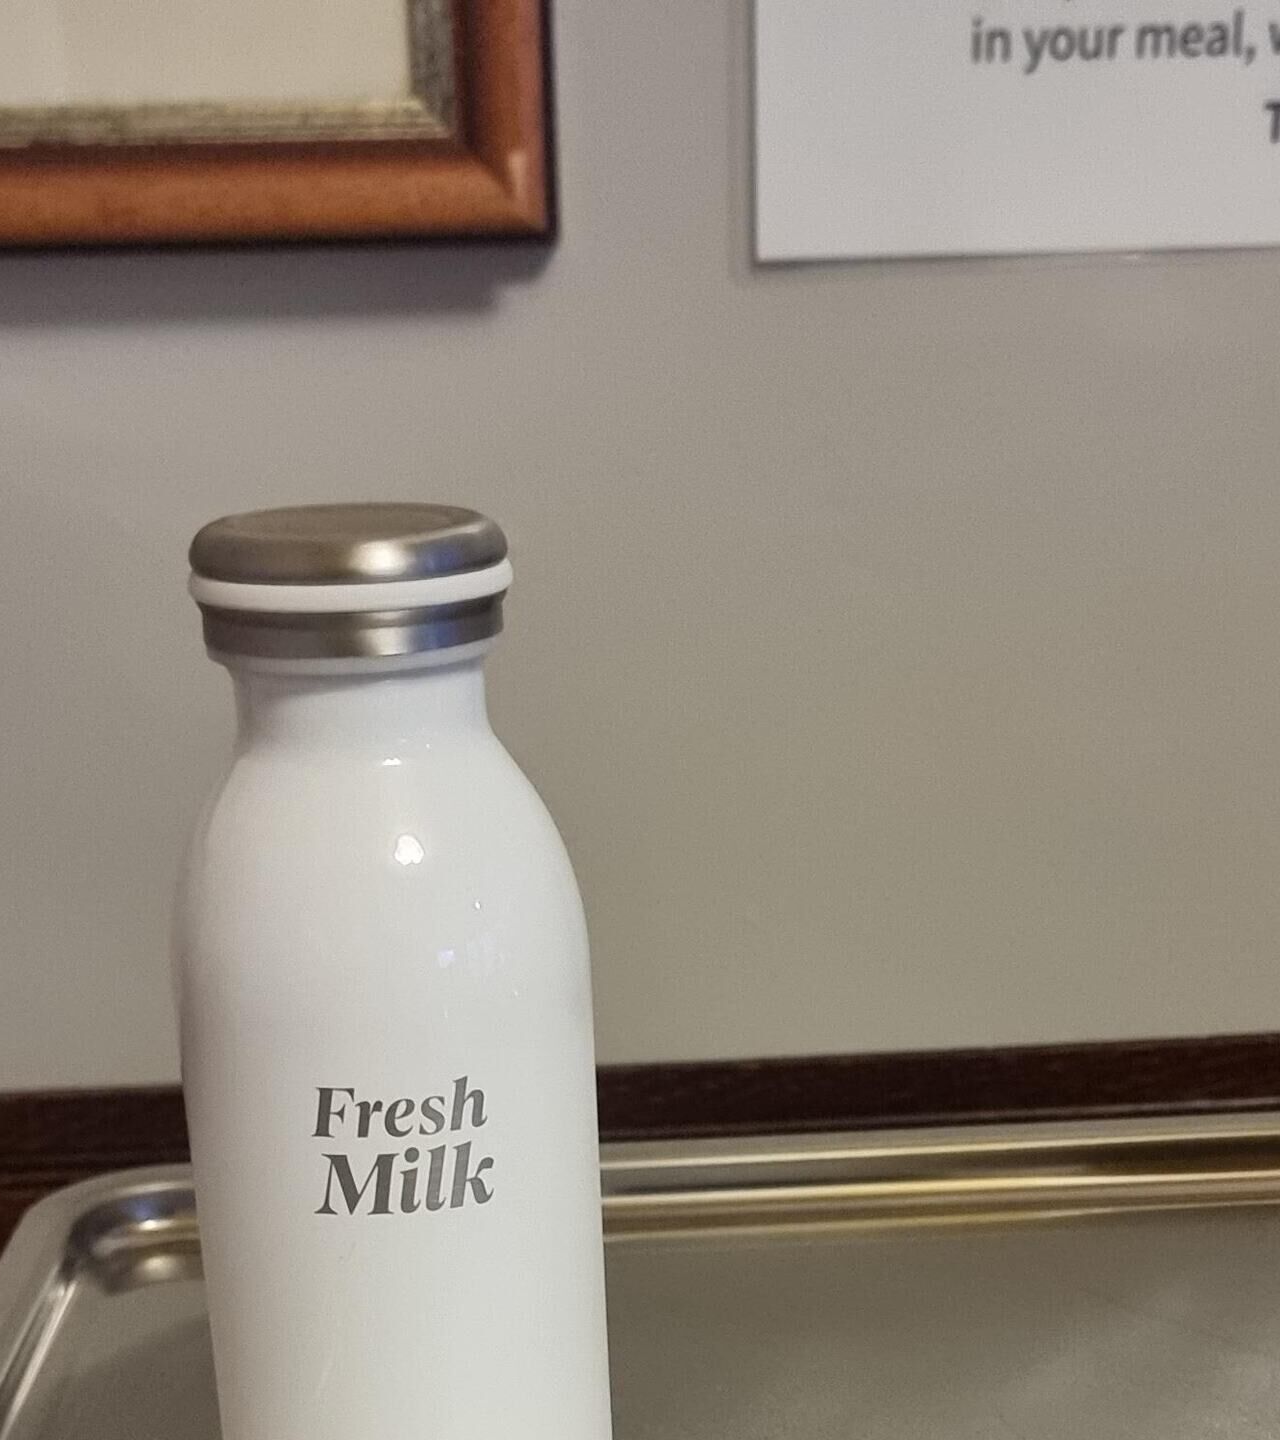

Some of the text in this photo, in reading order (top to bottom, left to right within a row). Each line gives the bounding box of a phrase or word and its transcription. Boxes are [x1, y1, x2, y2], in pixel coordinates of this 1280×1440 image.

[971, 16, 1012, 63] in
[1023, 23, 1124, 75] your
[1135, 8, 1256, 65] meal,
[311, 1075, 488, 1138] Fresh
[314, 1140, 495, 1216] Milk
